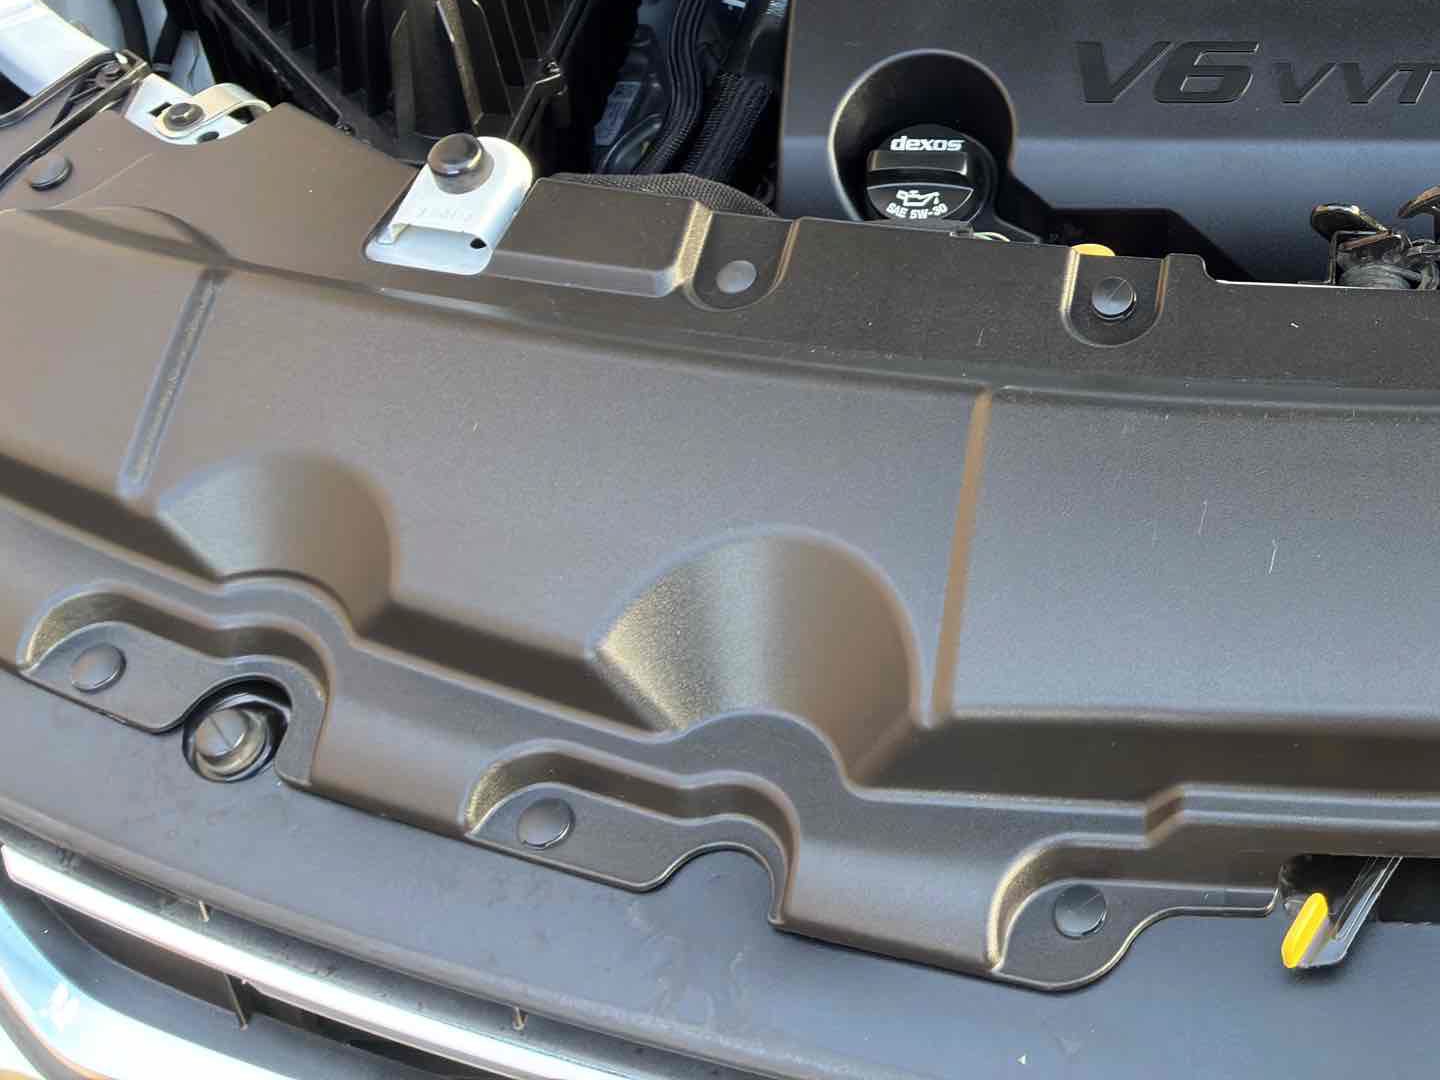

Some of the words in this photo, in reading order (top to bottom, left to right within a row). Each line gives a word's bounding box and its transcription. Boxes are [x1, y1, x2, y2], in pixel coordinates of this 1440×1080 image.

[1073, 40, 1261, 105] V6
[890, 135, 965, 151] dexos
[886, 203, 907, 218] SAE
[909, 203, 949, 220] 5W-30
